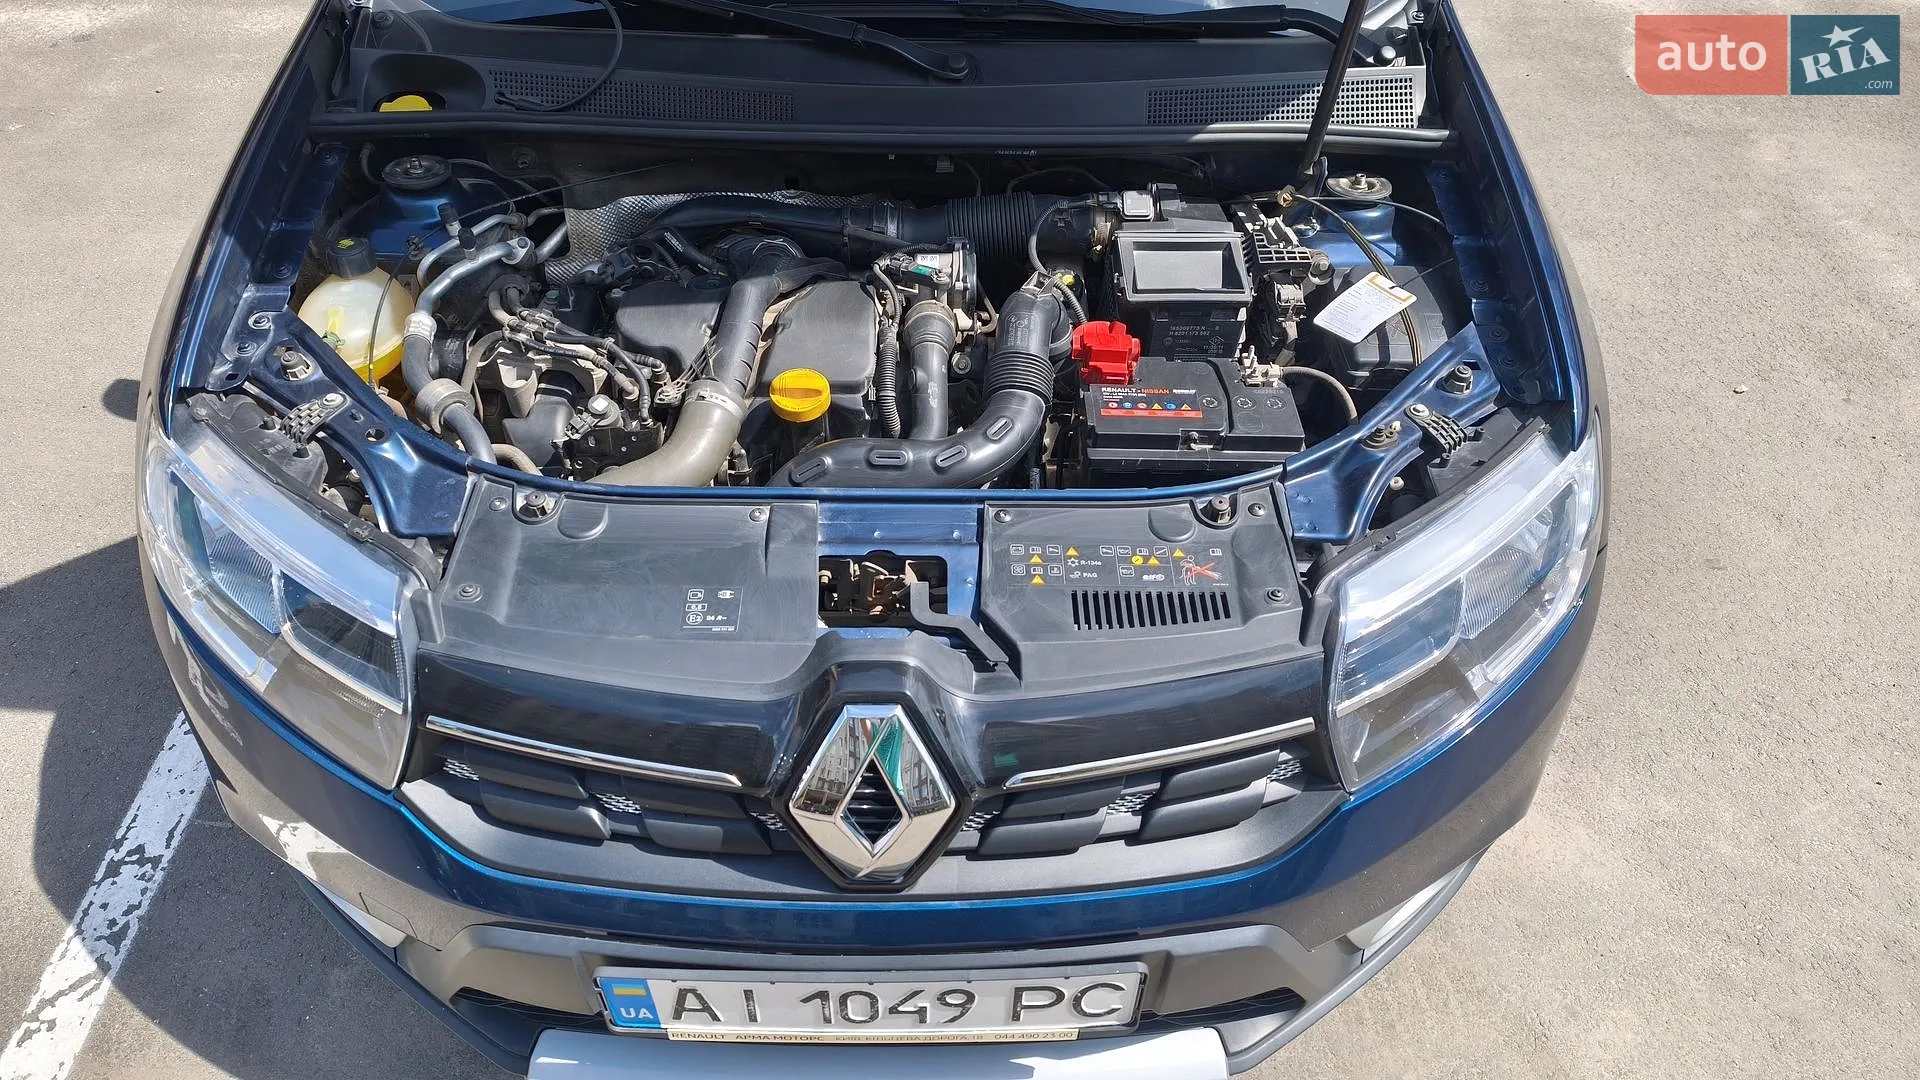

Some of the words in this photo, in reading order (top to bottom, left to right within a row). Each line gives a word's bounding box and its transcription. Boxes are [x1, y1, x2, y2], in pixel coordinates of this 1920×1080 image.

[800, 988, 977, 1024] 1049
[1012, 982, 1126, 1022] PC
[620, 1007, 654, 1019] UA
[671, 1032, 727, 1040] RENAULT
